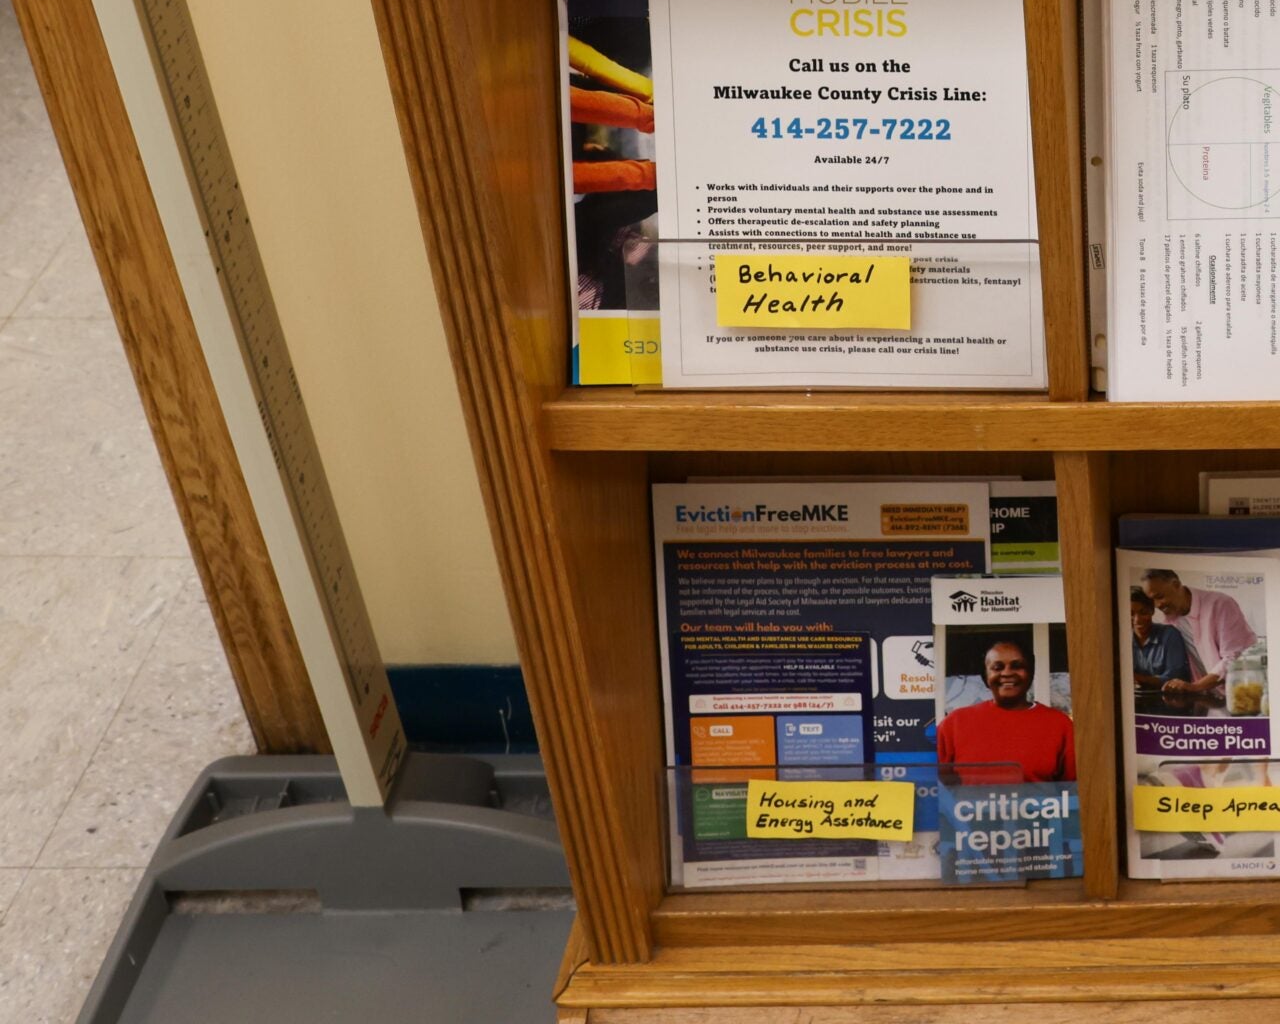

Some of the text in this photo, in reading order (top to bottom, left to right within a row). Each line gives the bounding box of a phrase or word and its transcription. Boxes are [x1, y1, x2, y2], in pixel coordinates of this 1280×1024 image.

[790, 8, 908, 37] CRISIS
[789, 58, 910, 72] Call us on the
[714, 85, 986, 103] Milwaukee County Crisis Line:
[1181, 75, 1191, 110] Su plato
[1262, 86, 1272, 134] Vegitables
[752, 117, 949, 139] 414-257-7222
[814, 155, 889, 164] Available 24/7
[1202, 146, 1210, 181] Proteina
[748, 206, 791, 215] voluntary
[737, 217, 788, 226] therapeutic
[871, 219, 898, 228] safety
[900, 219, 939, 228] planning
[739, 264, 874, 284] Behavioral
[743, 292, 844, 314] Health
[675, 504, 848, 522] EvictionFreeMKE
[980, 596, 1019, 606] Habitat
[895, 718, 919, 726] our
[1151, 724, 1243, 735] Your Diabetes
[1159, 736, 1266, 749] Game Plan
[760, 792, 879, 814] Housing and
[954, 791, 1070, 820] critical
[1156, 797, 1212, 820] Sleep
[756, 812, 902, 833] Energy Assistance
[954, 822, 1055, 855] repair
